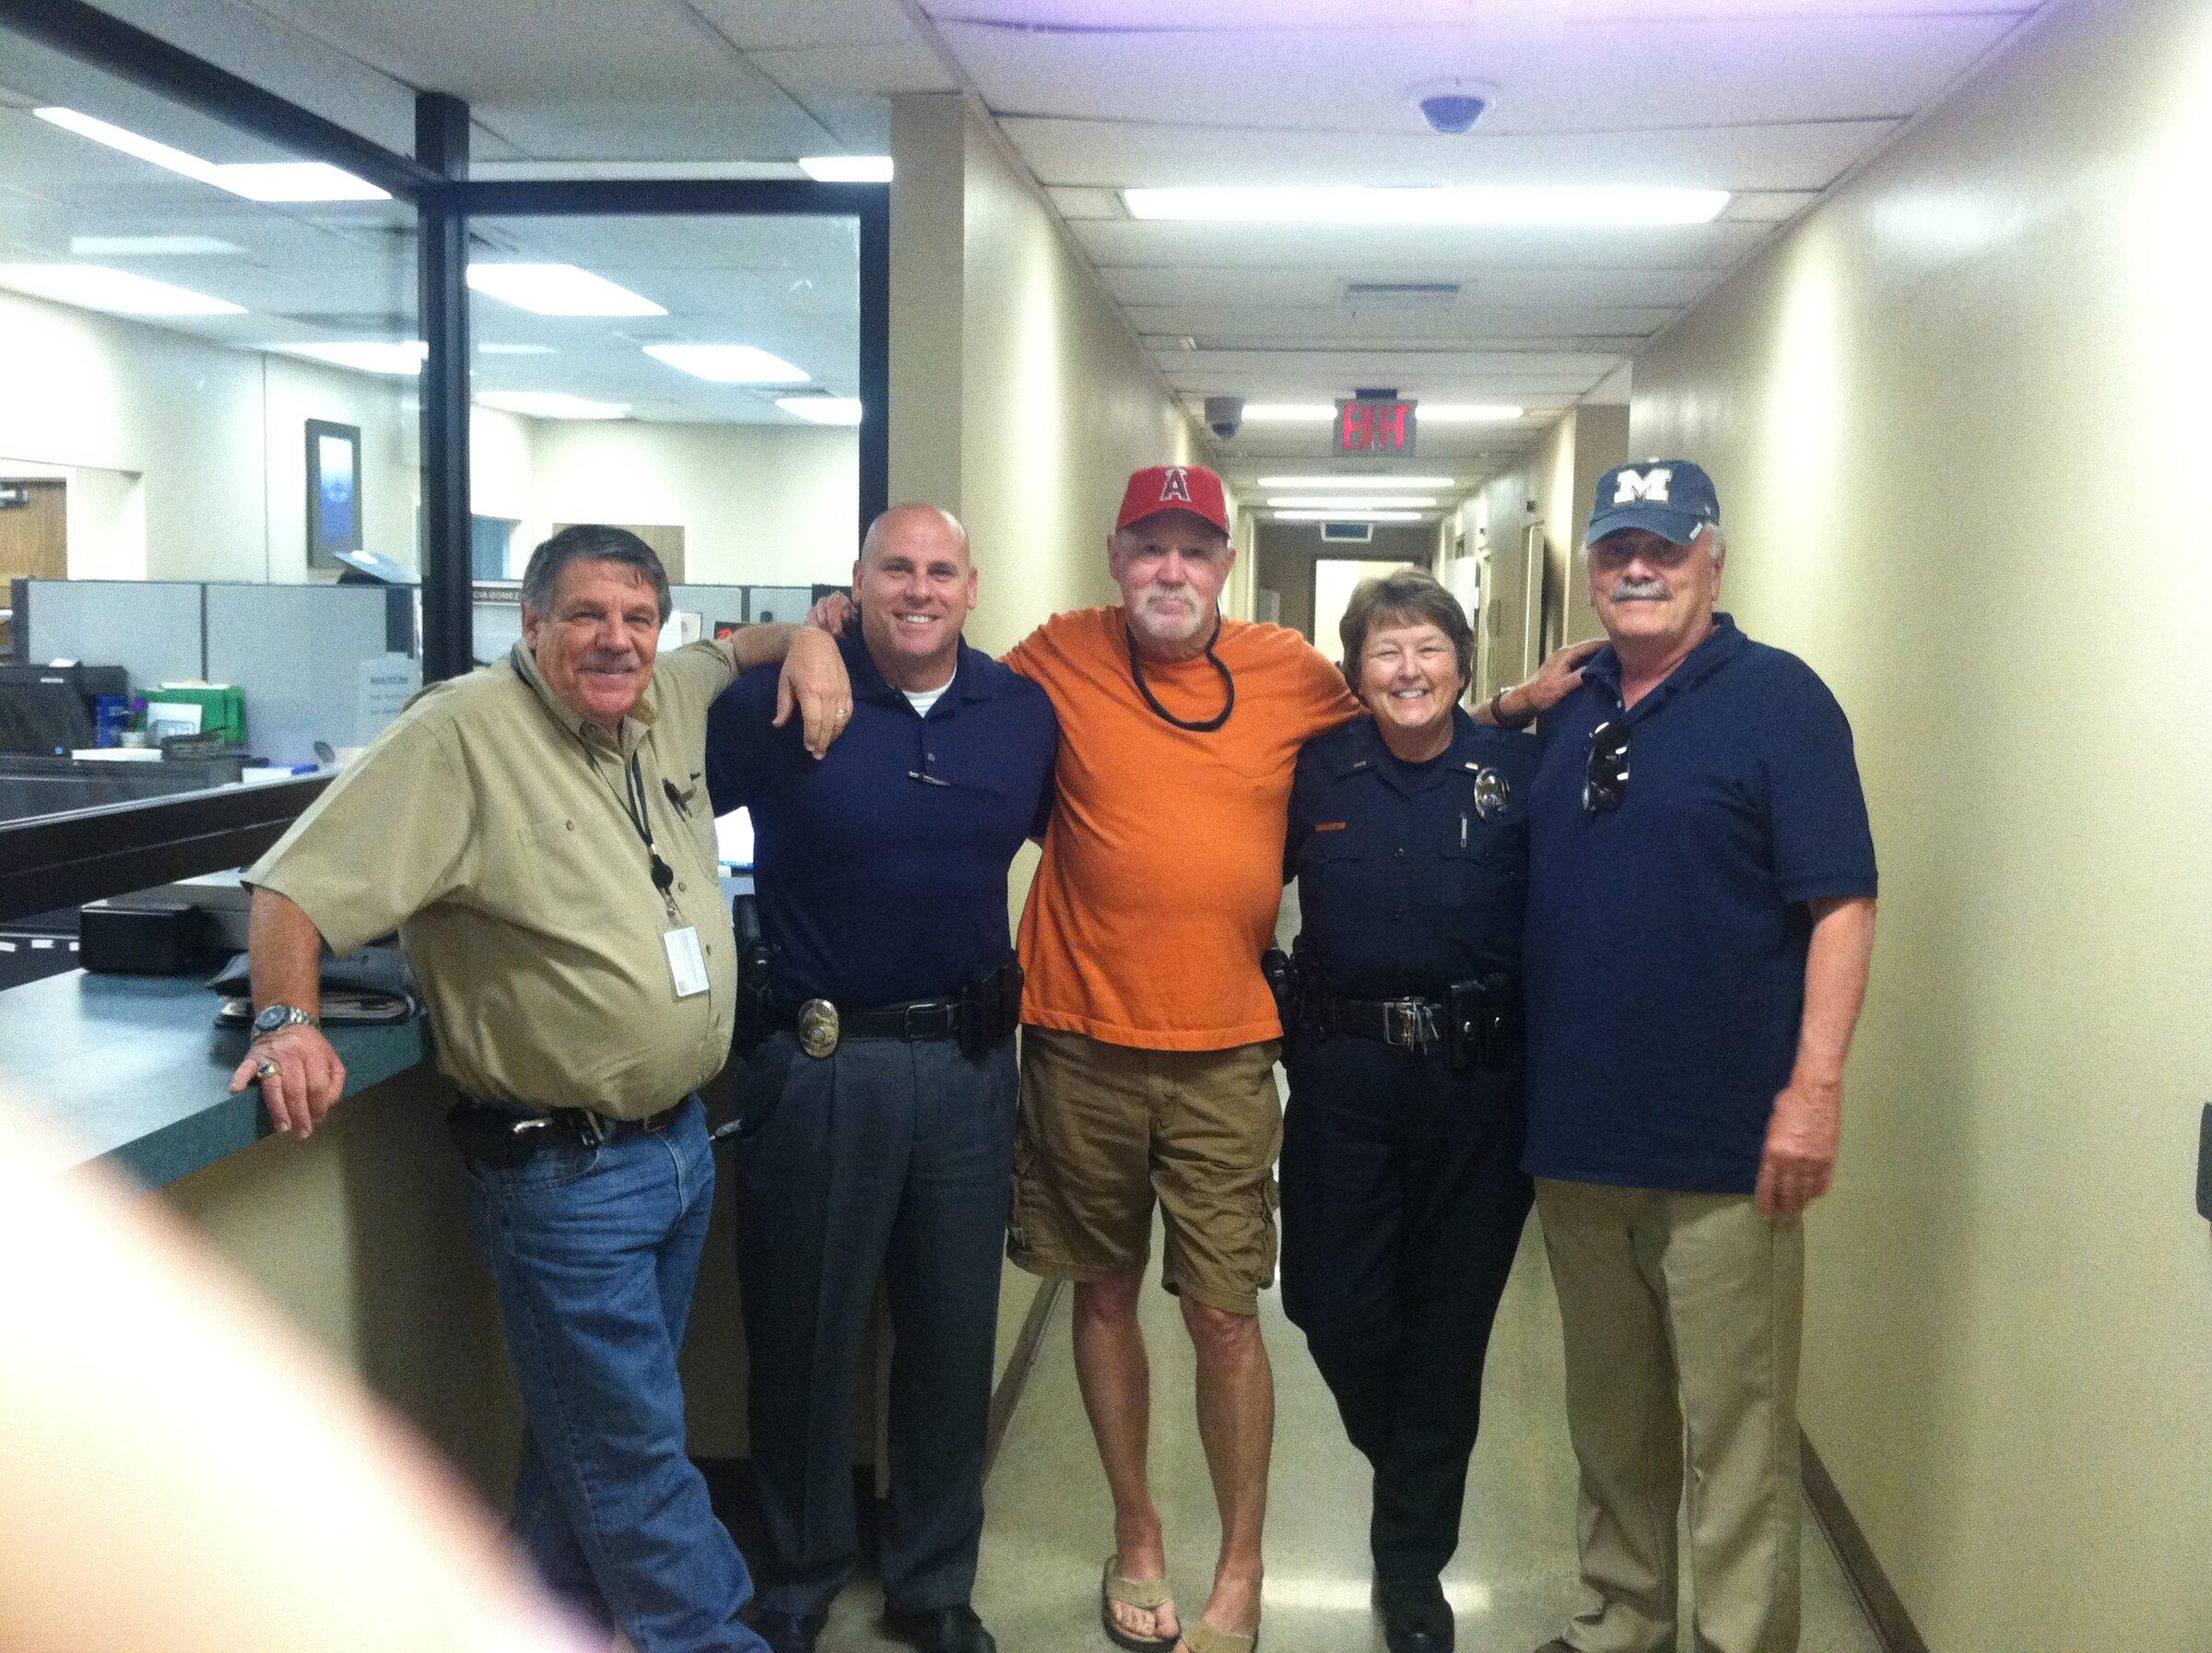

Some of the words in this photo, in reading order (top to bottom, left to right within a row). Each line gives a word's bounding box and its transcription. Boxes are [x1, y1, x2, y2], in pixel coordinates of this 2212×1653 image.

[1343, 403, 1410, 449] EXIT
[1159, 467, 1194, 502] A
[1614, 468, 1673, 503] M
